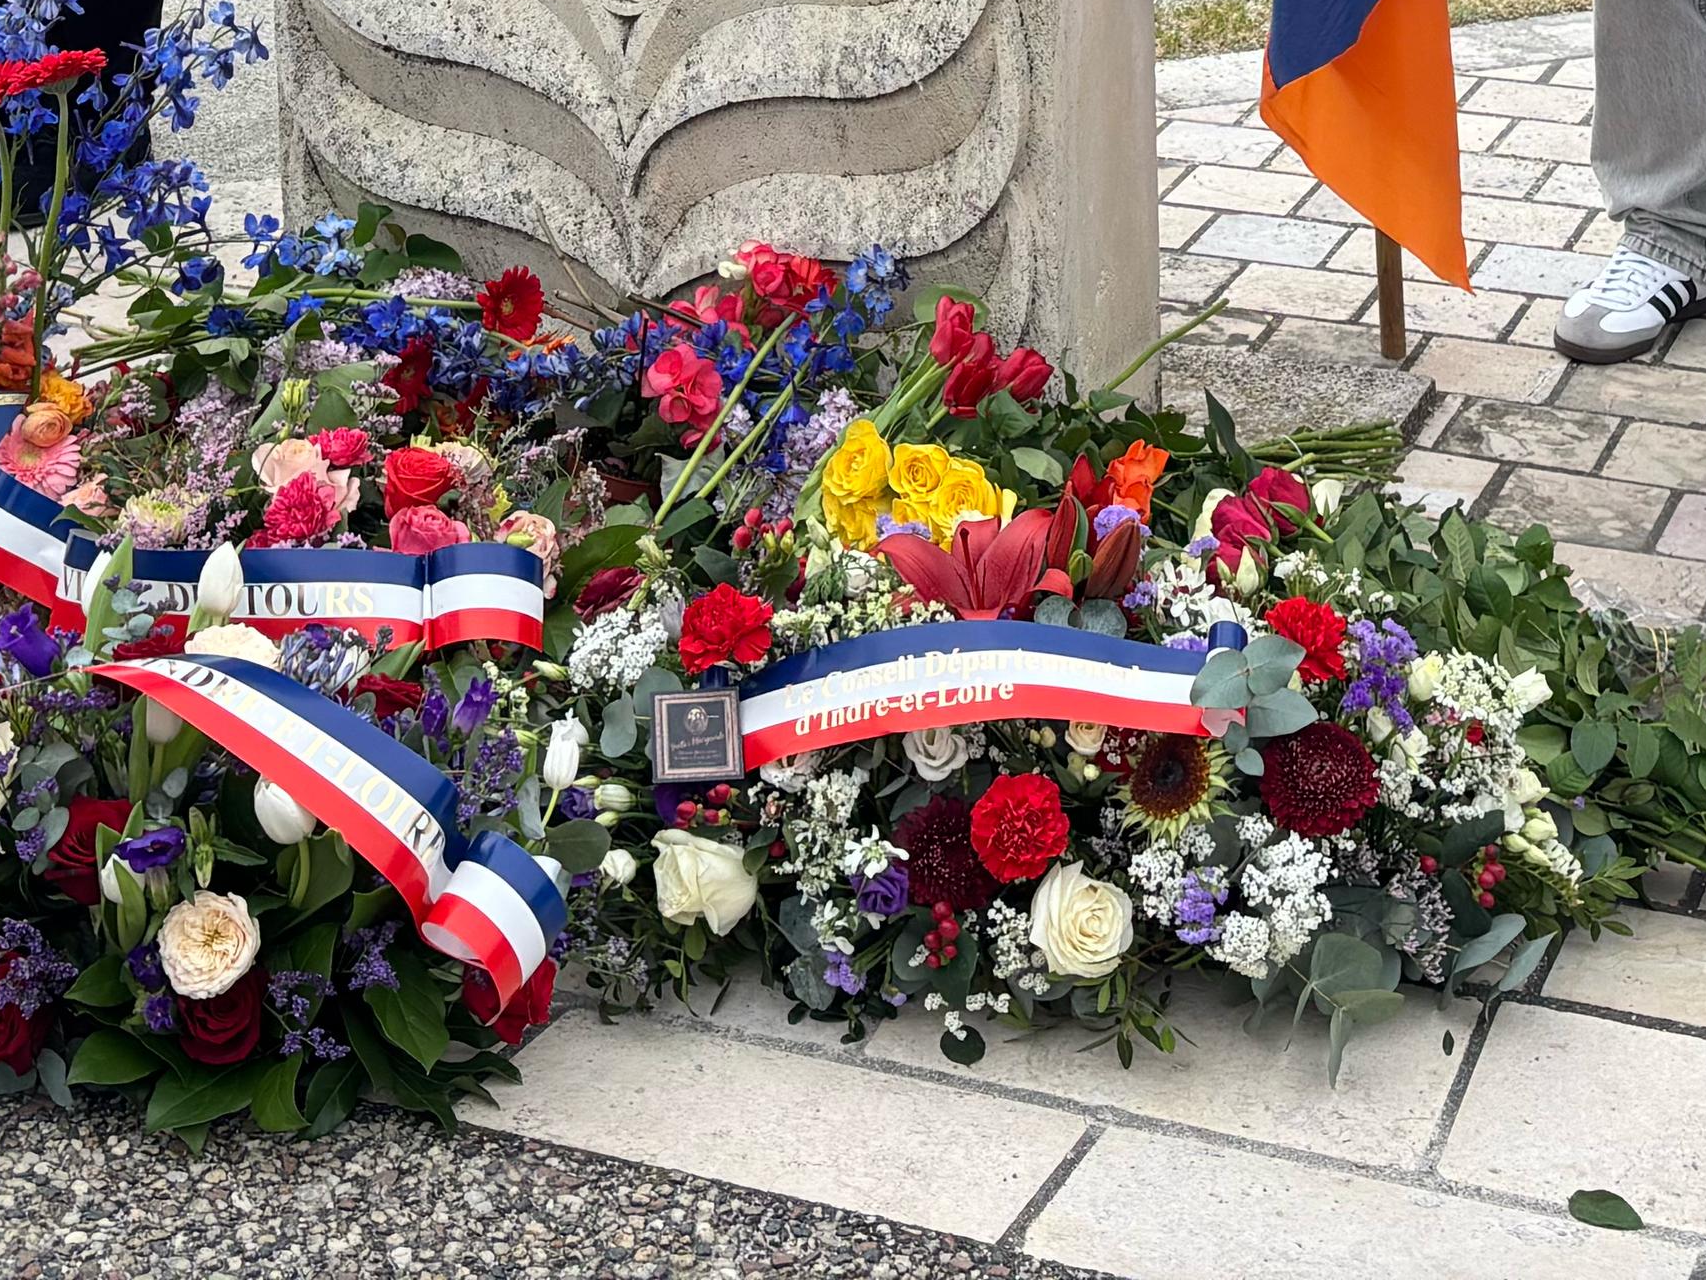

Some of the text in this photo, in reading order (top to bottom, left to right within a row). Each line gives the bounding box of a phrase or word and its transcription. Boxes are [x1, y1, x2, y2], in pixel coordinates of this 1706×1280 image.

[243, 583, 375, 617] TOURS
[783, 646, 1142, 710] Le Conseil Départemental
[794, 680, 1015, 737] d'Indre-et-Loire
